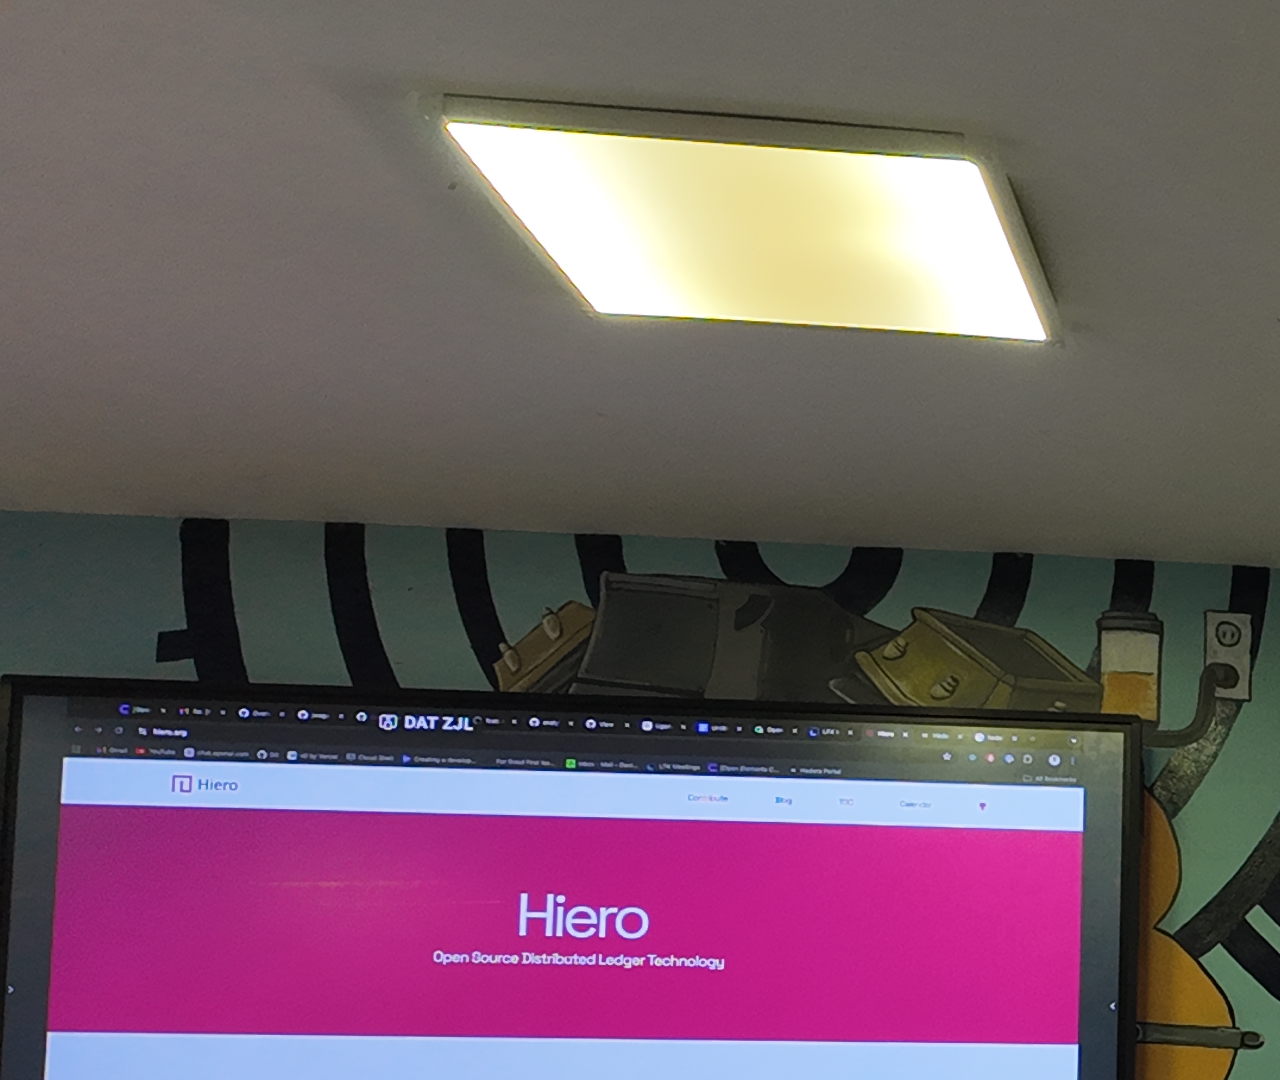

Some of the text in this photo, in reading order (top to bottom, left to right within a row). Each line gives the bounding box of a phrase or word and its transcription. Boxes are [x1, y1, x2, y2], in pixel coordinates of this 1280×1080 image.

[404, 715, 438, 730] DAT
[442, 716, 474, 731] ZJL
[197, 778, 239, 791] Hiero
[518, 892, 649, 939] Hiero
[433, 950, 725, 970] Open Source Distributed Ledger Technology
